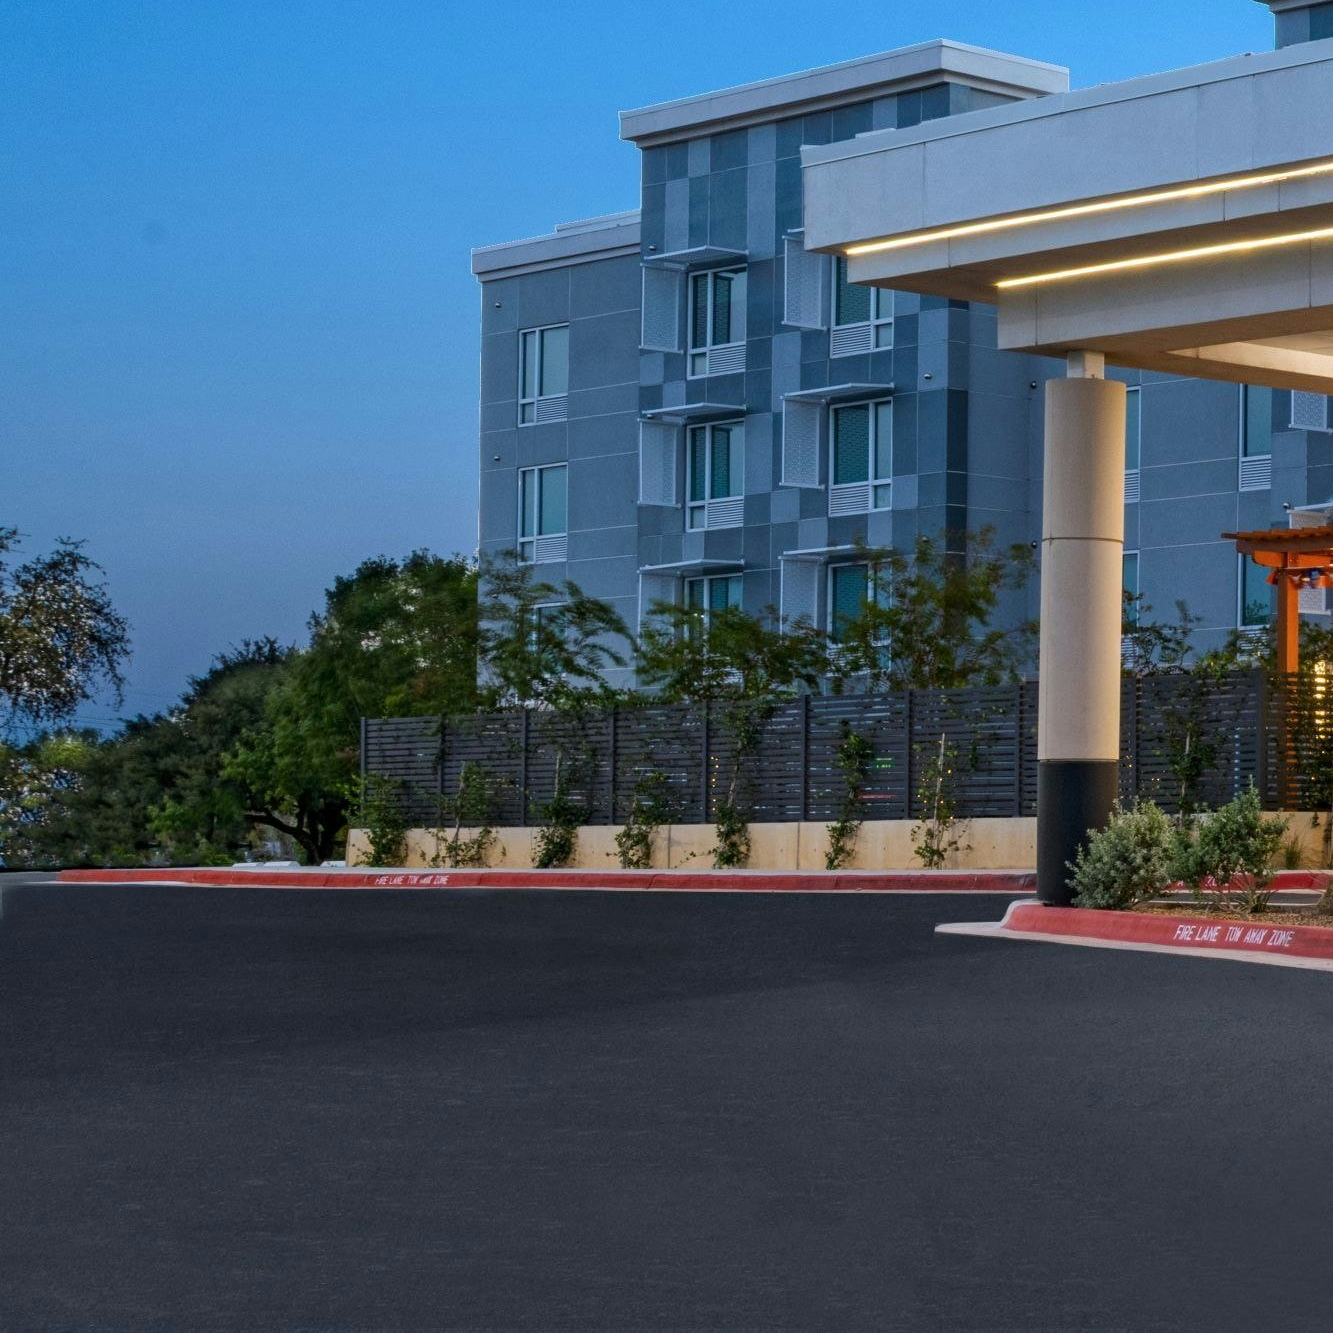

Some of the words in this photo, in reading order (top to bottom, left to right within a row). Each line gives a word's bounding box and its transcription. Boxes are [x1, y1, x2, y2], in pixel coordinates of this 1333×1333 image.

[1173, 924, 1196, 941] FIRE
[1195, 925, 1222, 942] LANE
[1225, 926, 1244, 942] TOW
[1243, 928, 1268, 946] AWAY
[1267, 929, 1295, 947] ZONE
